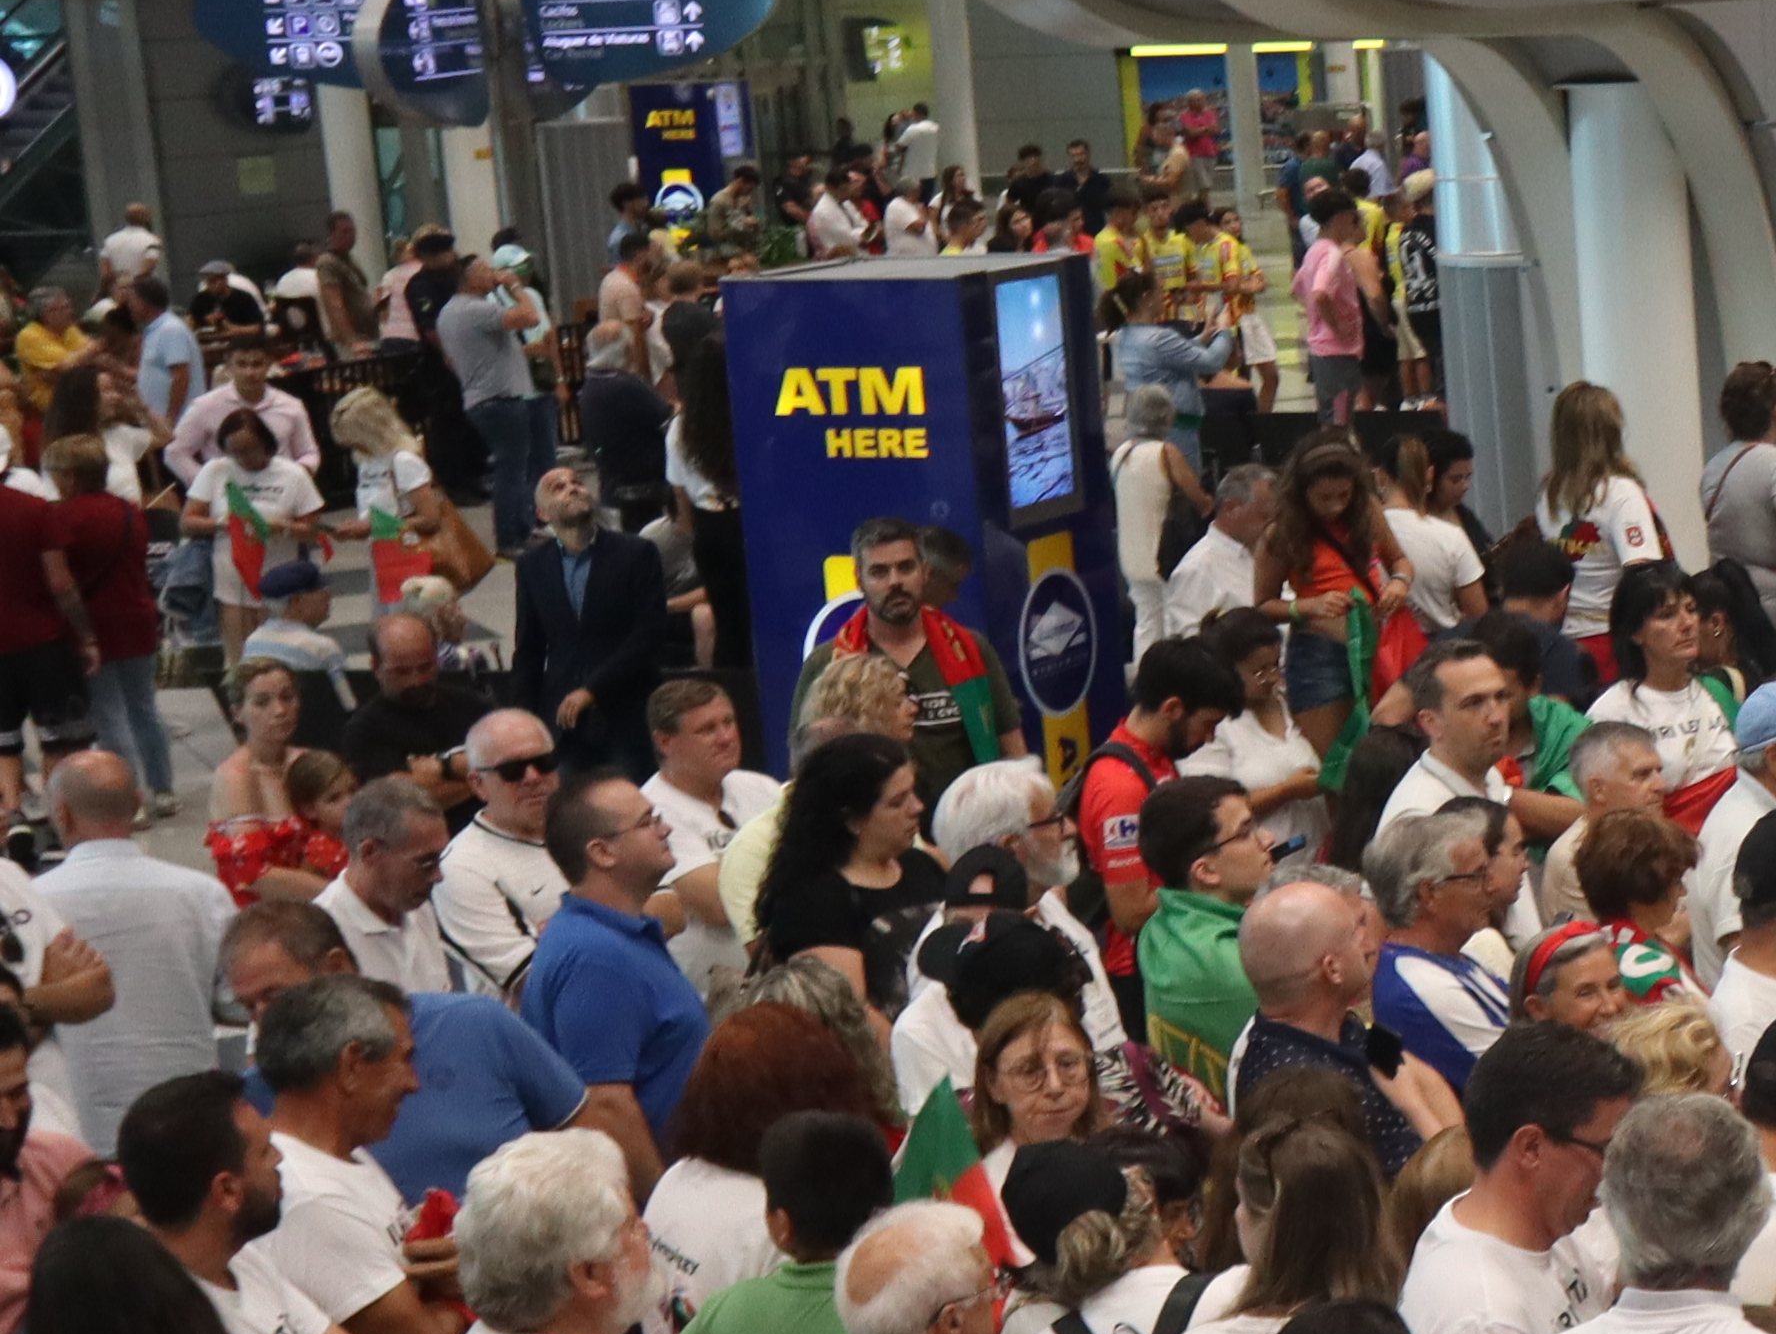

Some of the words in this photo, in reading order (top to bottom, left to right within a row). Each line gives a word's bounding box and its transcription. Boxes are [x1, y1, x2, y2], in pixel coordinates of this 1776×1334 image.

[645, 109, 695, 129] ATM
[775, 367, 926, 416] ATM
[825, 427, 929, 458] HERE
